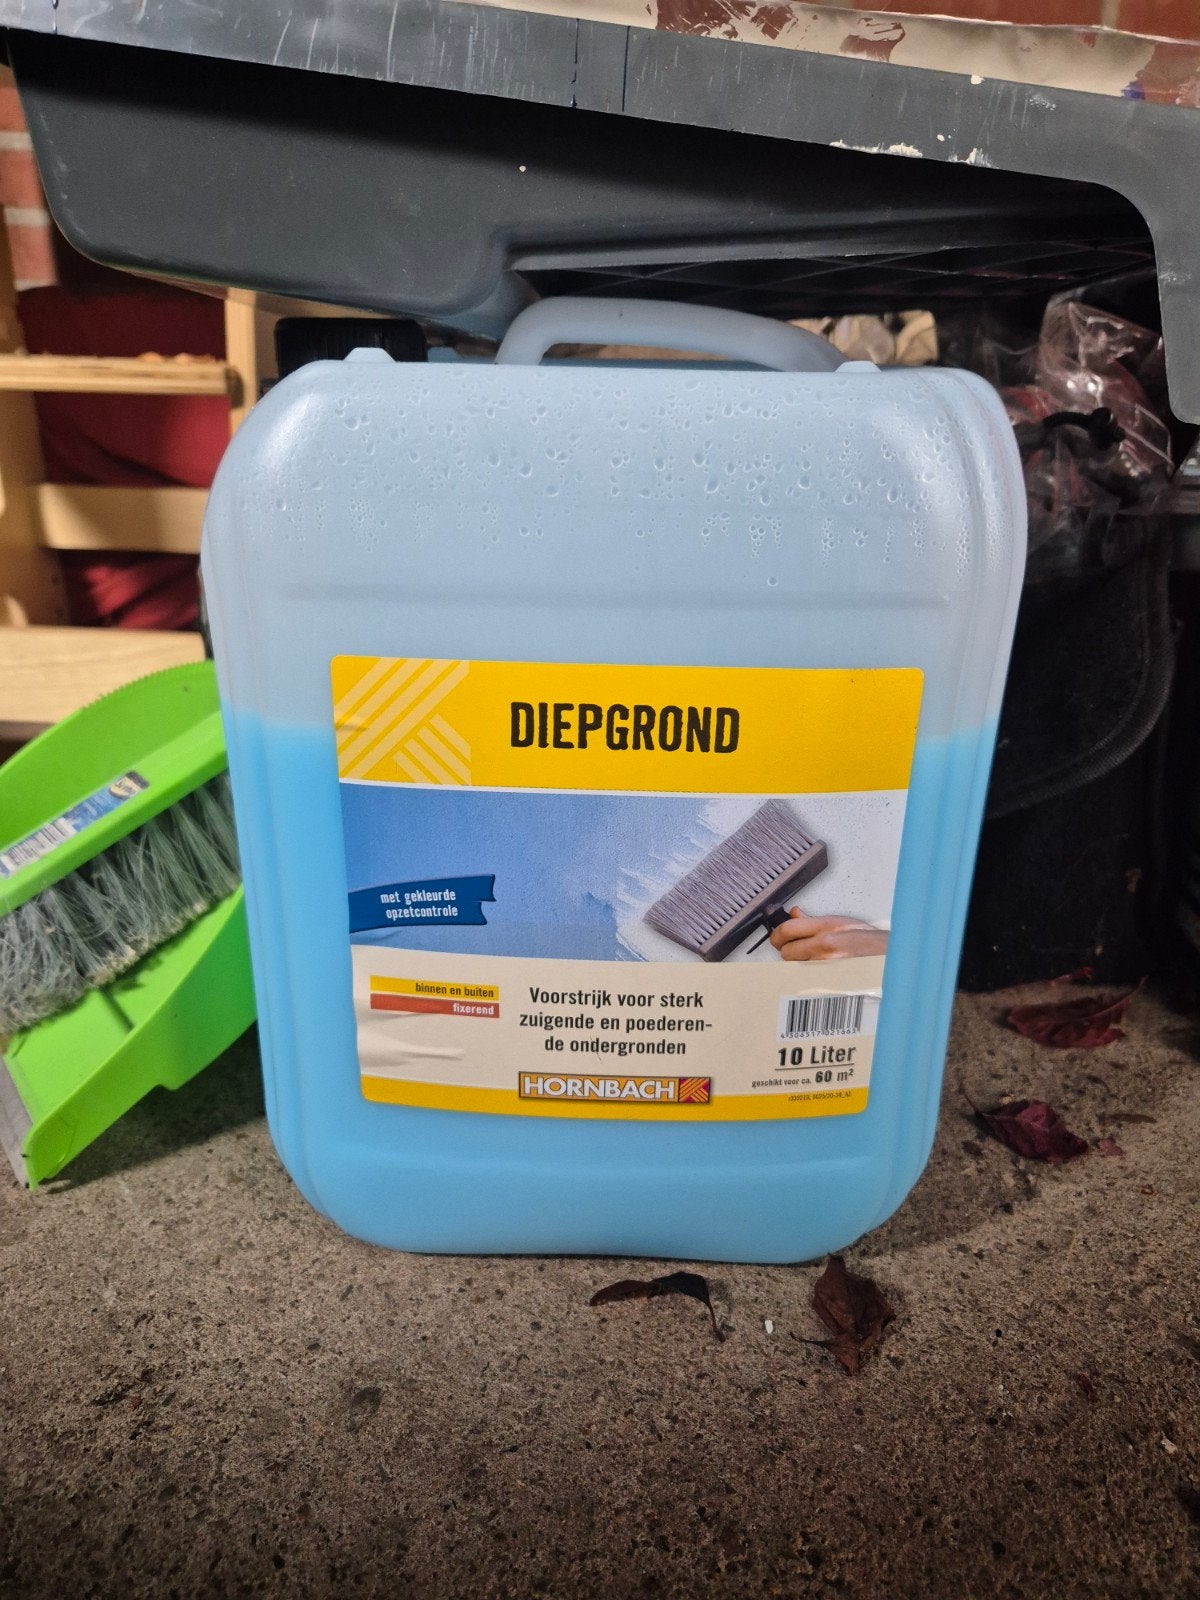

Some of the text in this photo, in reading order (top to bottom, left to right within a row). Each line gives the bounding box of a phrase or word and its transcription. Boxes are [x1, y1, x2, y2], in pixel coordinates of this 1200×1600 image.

[510, 701, 740, 754] DIEPGROND
[380, 889, 456, 906] met gekleurde
[385, 904, 459, 921] opzetcontrole
[415, 982, 494, 998] binnen en buiten
[529, 987, 704, 1009] Voorstrijk voor sterk
[452, 1002, 495, 1016] fixerend
[519, 1012, 713, 1034] zuigende en poederen-
[544, 1036, 687, 1057] de ondergronden
[778, 1045, 857, 1067] 10 Liter
[523, 1075, 676, 1100] HORNBACH
[751, 1078, 782, 1088] geschikt
[783, 1078, 799, 1086] voor
[801, 1077, 812, 1085] ca.
[814, 1069, 833, 1084] 60
